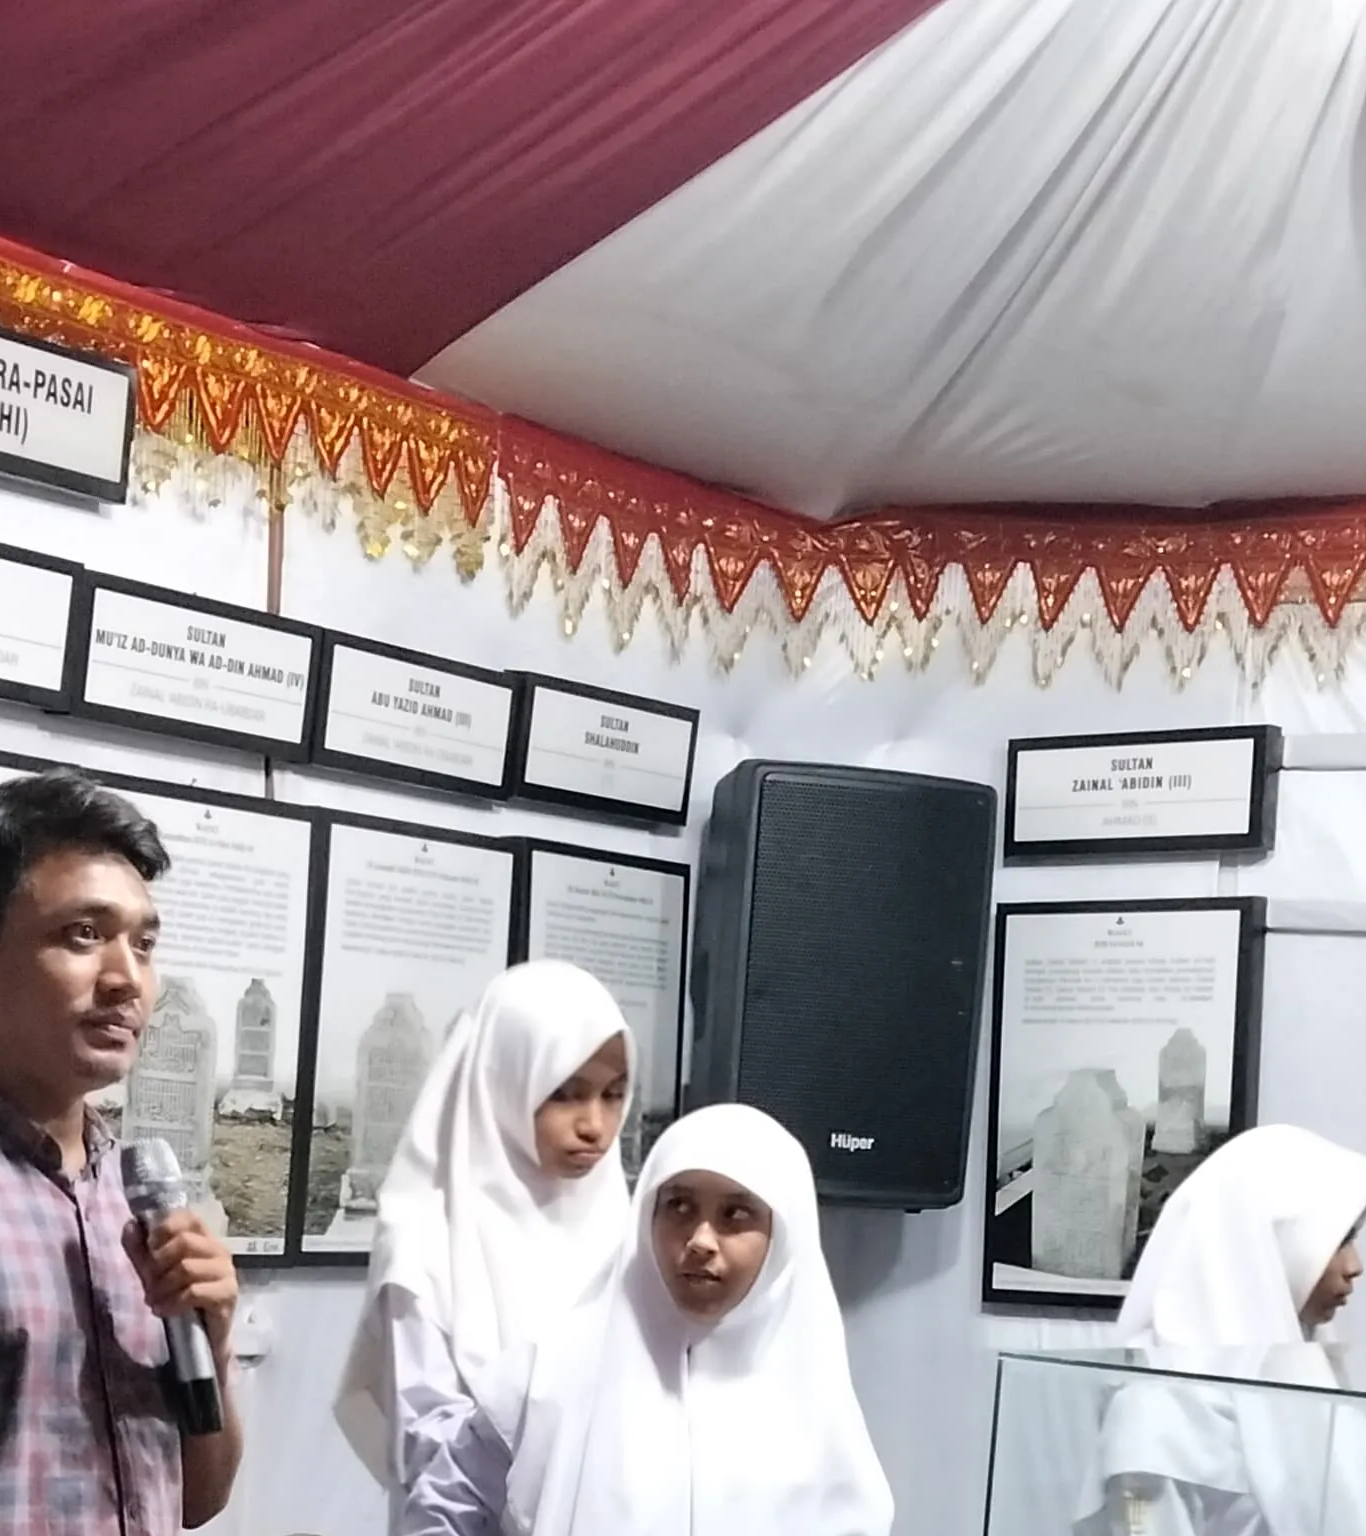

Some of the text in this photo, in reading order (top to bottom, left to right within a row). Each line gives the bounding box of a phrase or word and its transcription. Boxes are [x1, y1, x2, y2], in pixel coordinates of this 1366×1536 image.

[186, 625, 227, 648] SULTAN
[130, 636, 186, 663] AD-DUNYA
[189, 650, 205, 667] WA
[208, 654, 245, 675] AD-DIN
[247, 663, 284, 684] AHMAD
[408, 678, 441, 698] SULTAN
[371, 691, 390, 708] ABU
[393, 696, 418, 715] YAZID
[421, 703, 452, 723] AHMAD
[600, 714, 629, 733] SULTAN
[1111, 758, 1153, 771] SULTAN
[1072, 778, 1113, 792] ZAINAL
[1169, 775, 1191, 790] (III)
